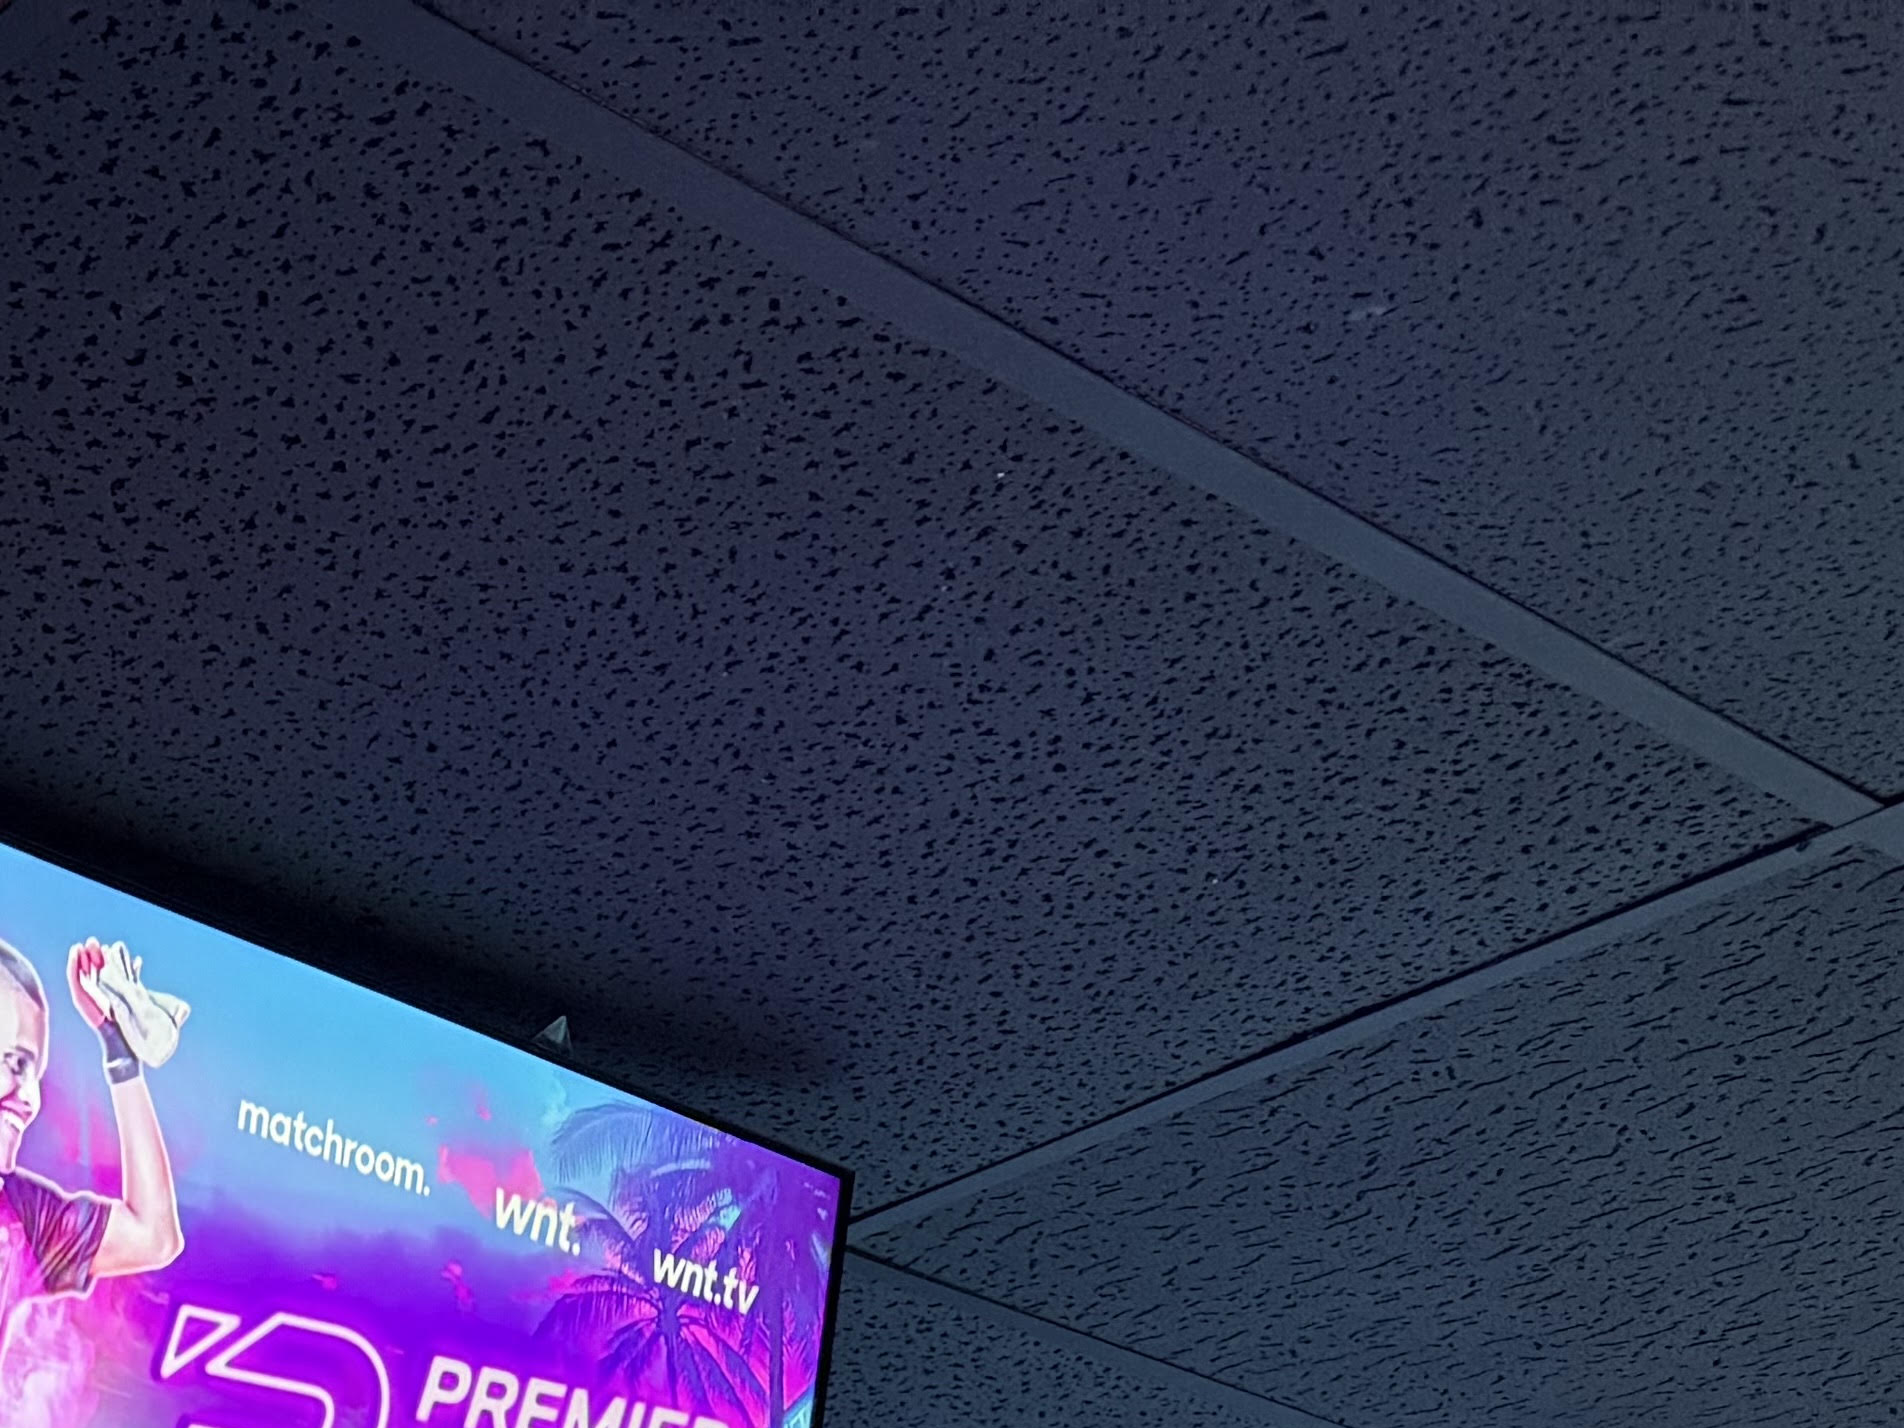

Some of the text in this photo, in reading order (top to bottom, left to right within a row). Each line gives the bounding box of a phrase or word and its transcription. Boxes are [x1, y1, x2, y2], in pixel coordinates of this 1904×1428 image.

[237, 1098, 762, 1315] matchroom. wnt. wnt.tv
